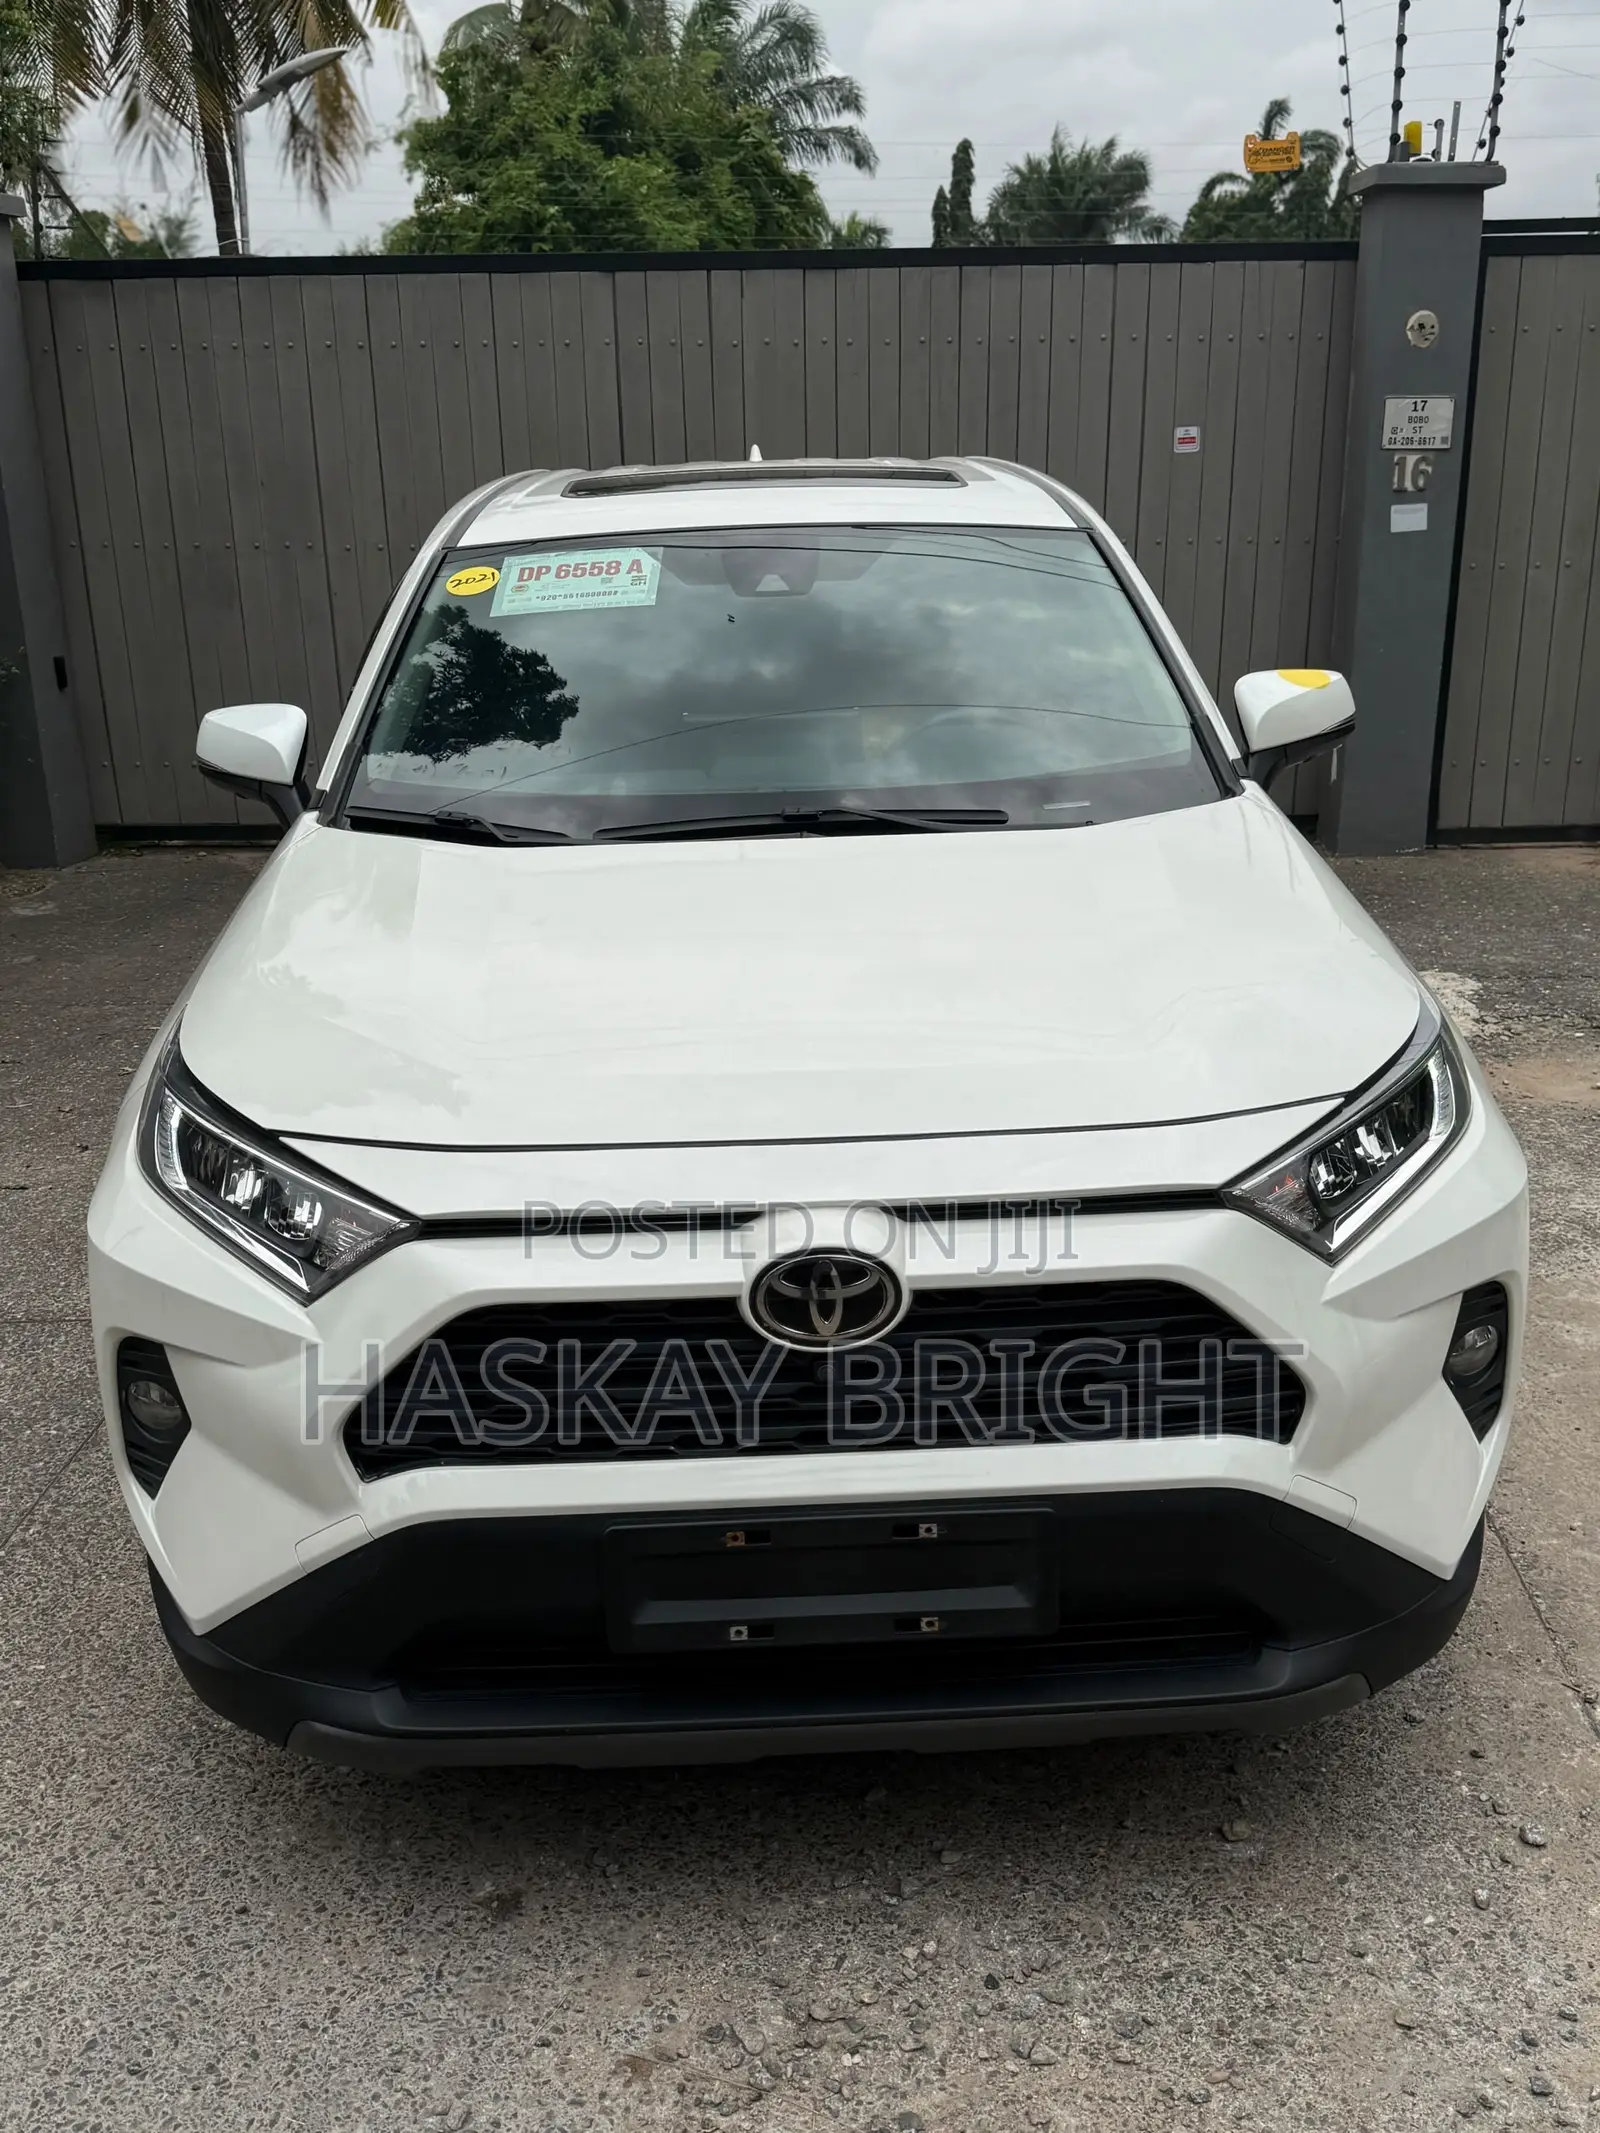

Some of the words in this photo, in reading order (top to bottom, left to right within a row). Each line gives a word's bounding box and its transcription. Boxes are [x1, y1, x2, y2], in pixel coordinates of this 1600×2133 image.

[1411, 400, 1428, 412] 17
[1408, 416, 1430, 424] BOBO
[1412, 426, 1424, 434] ST
[1392, 455, 1433, 493] 16
[517, 565, 552, 582] DP
[554, 560, 622, 579] 6558
[625, 559, 643, 575] A
[449, 571, 496, 589] 2021
